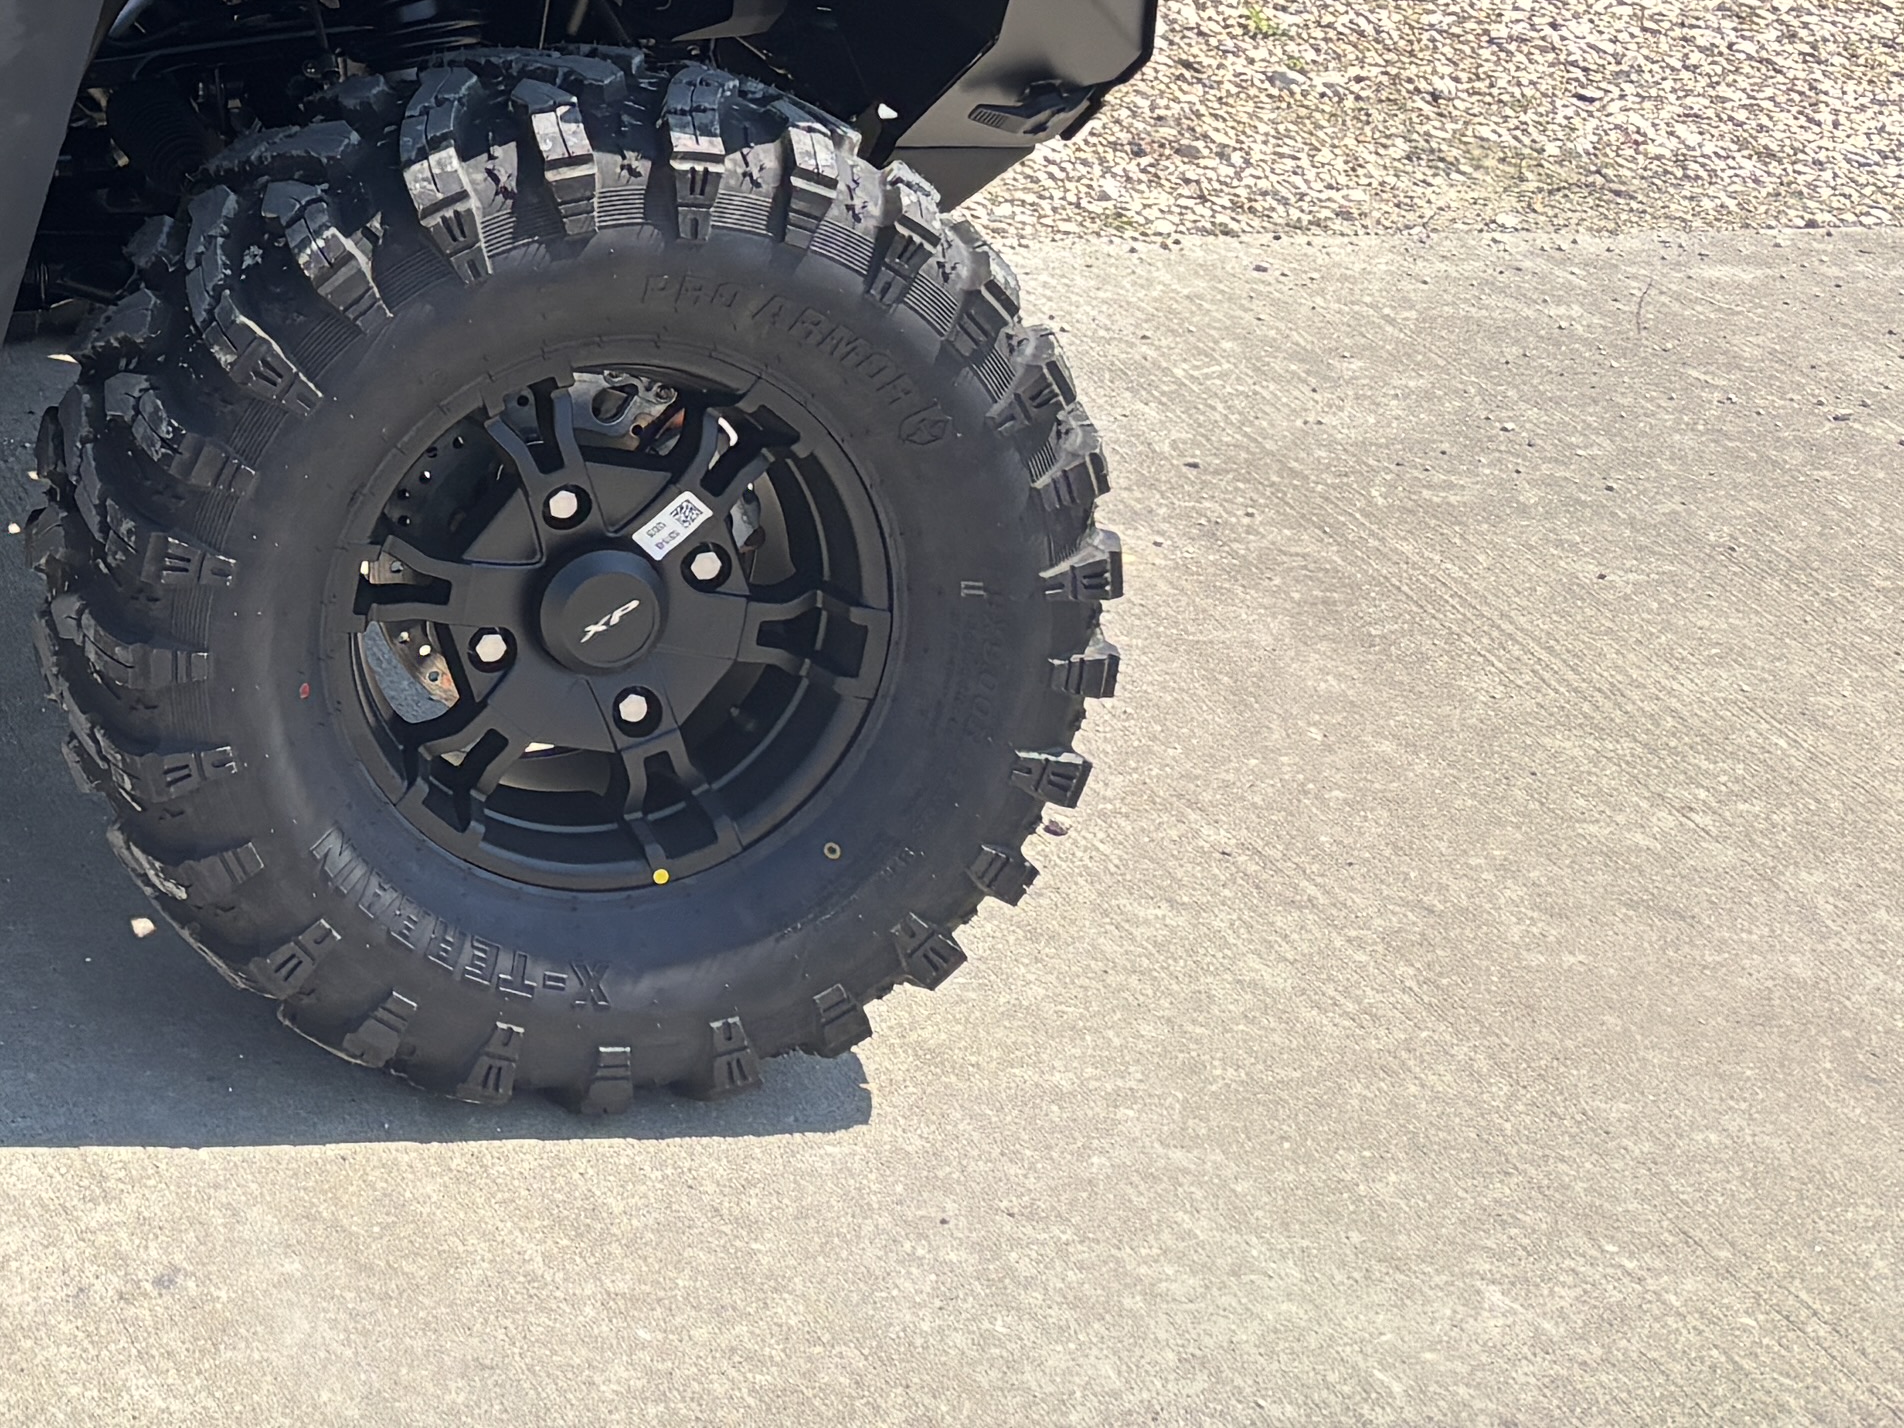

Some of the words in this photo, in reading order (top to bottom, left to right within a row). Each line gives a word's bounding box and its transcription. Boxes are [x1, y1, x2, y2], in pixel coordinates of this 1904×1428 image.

[641, 274, 742, 309] PRO
[750, 294, 918, 406] ARMOR
[580, 599, 640, 644] XP
[308, 824, 612, 1008] X-TERRAIN
